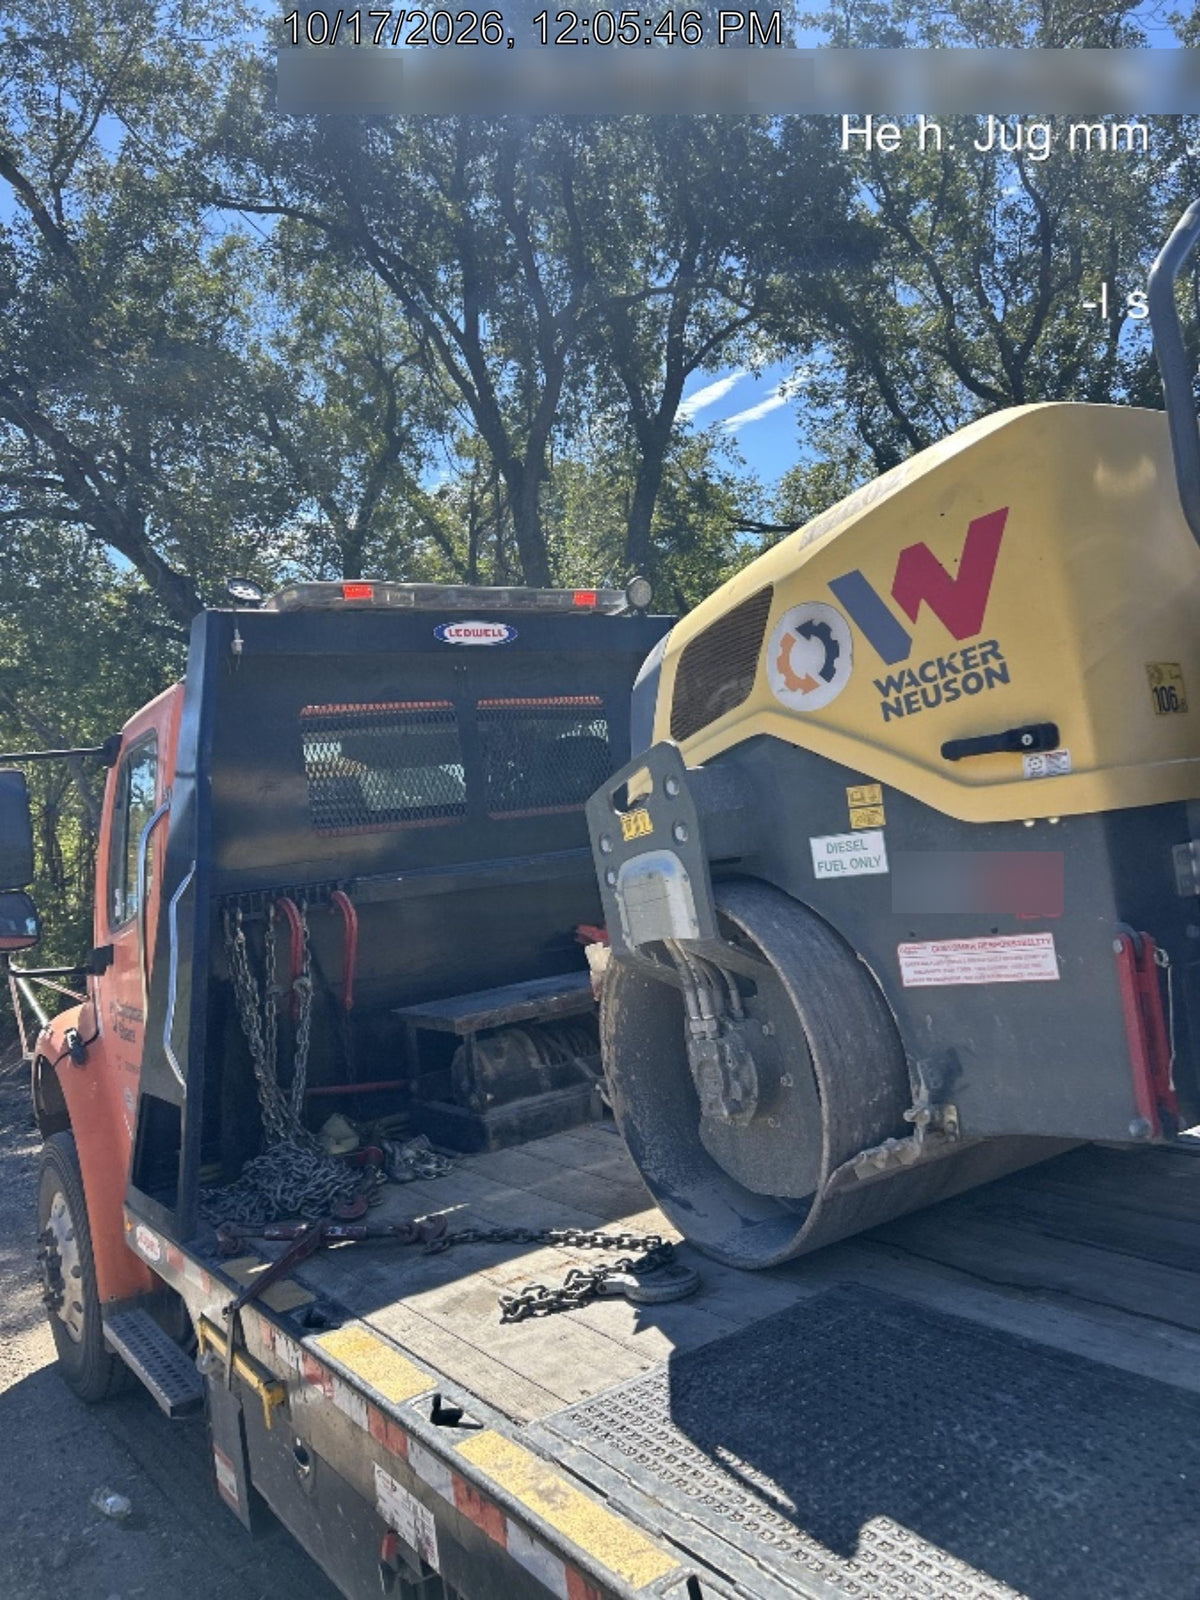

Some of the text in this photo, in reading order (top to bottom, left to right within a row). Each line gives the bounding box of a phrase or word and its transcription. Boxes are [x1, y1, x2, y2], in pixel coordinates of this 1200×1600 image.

[448, 628, 505, 637] LEDWELL
[873, 639, 1004, 698] WACKER
[880, 661, 1011, 722] NEUSON
[1152, 685, 1178, 712] 106
[826, 839, 868, 854] DIESEL
[817, 855, 881, 873] FUEL ONLY
